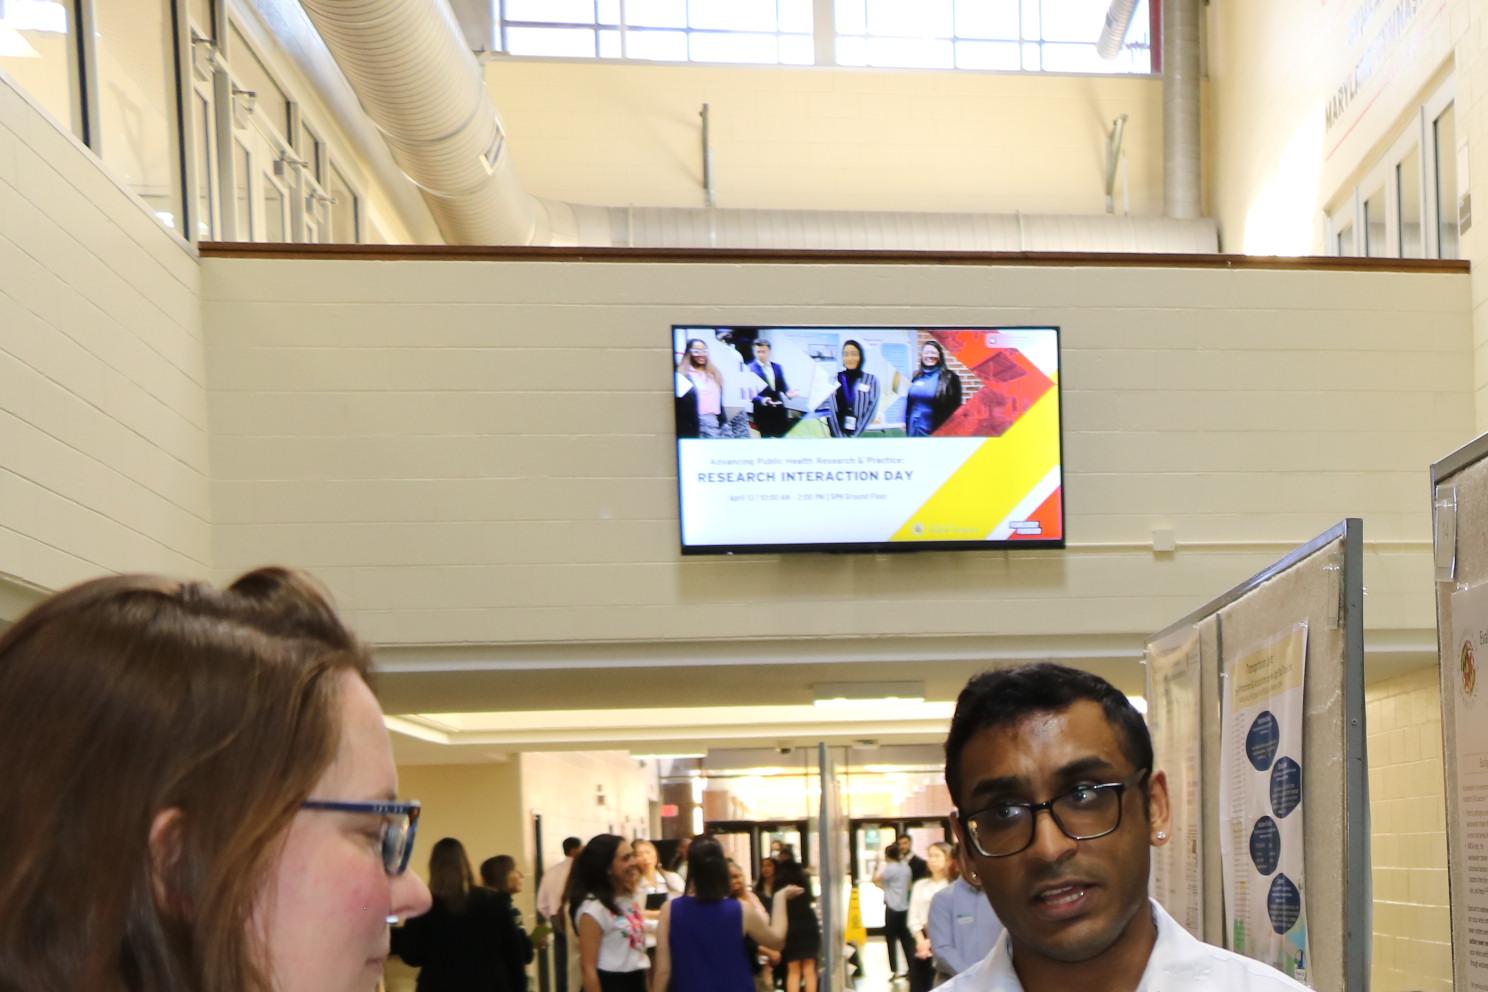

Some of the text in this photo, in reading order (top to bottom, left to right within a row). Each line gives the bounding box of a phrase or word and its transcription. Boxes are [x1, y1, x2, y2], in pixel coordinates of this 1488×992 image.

[697, 470, 914, 483] RESEARCH INTERACTION DAY
